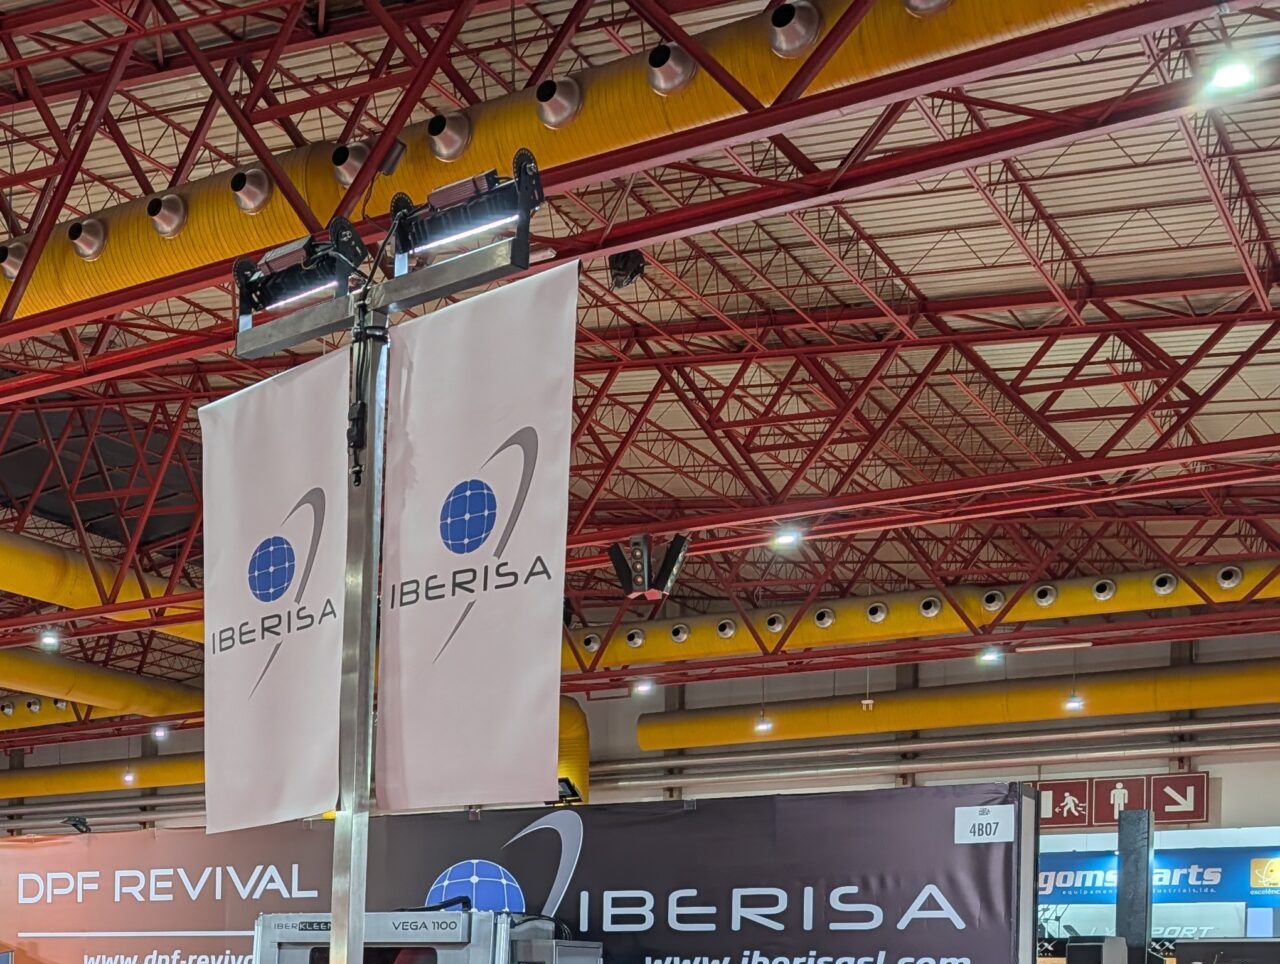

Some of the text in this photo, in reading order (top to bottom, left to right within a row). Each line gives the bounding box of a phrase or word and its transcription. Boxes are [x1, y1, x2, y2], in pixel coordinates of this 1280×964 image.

[390, 556, 551, 609] IBERISA
[212, 598, 337, 655] IBERISA
[969, 822, 1000, 837] 4B07
[18, 864, 318, 904] DPF REVIVAL
[1038, 864, 1222, 895] gomsarts
[392, 921, 428, 931] VEGA
[432, 921, 457, 931] 1100
[579, 883, 967, 932] IBERISA
